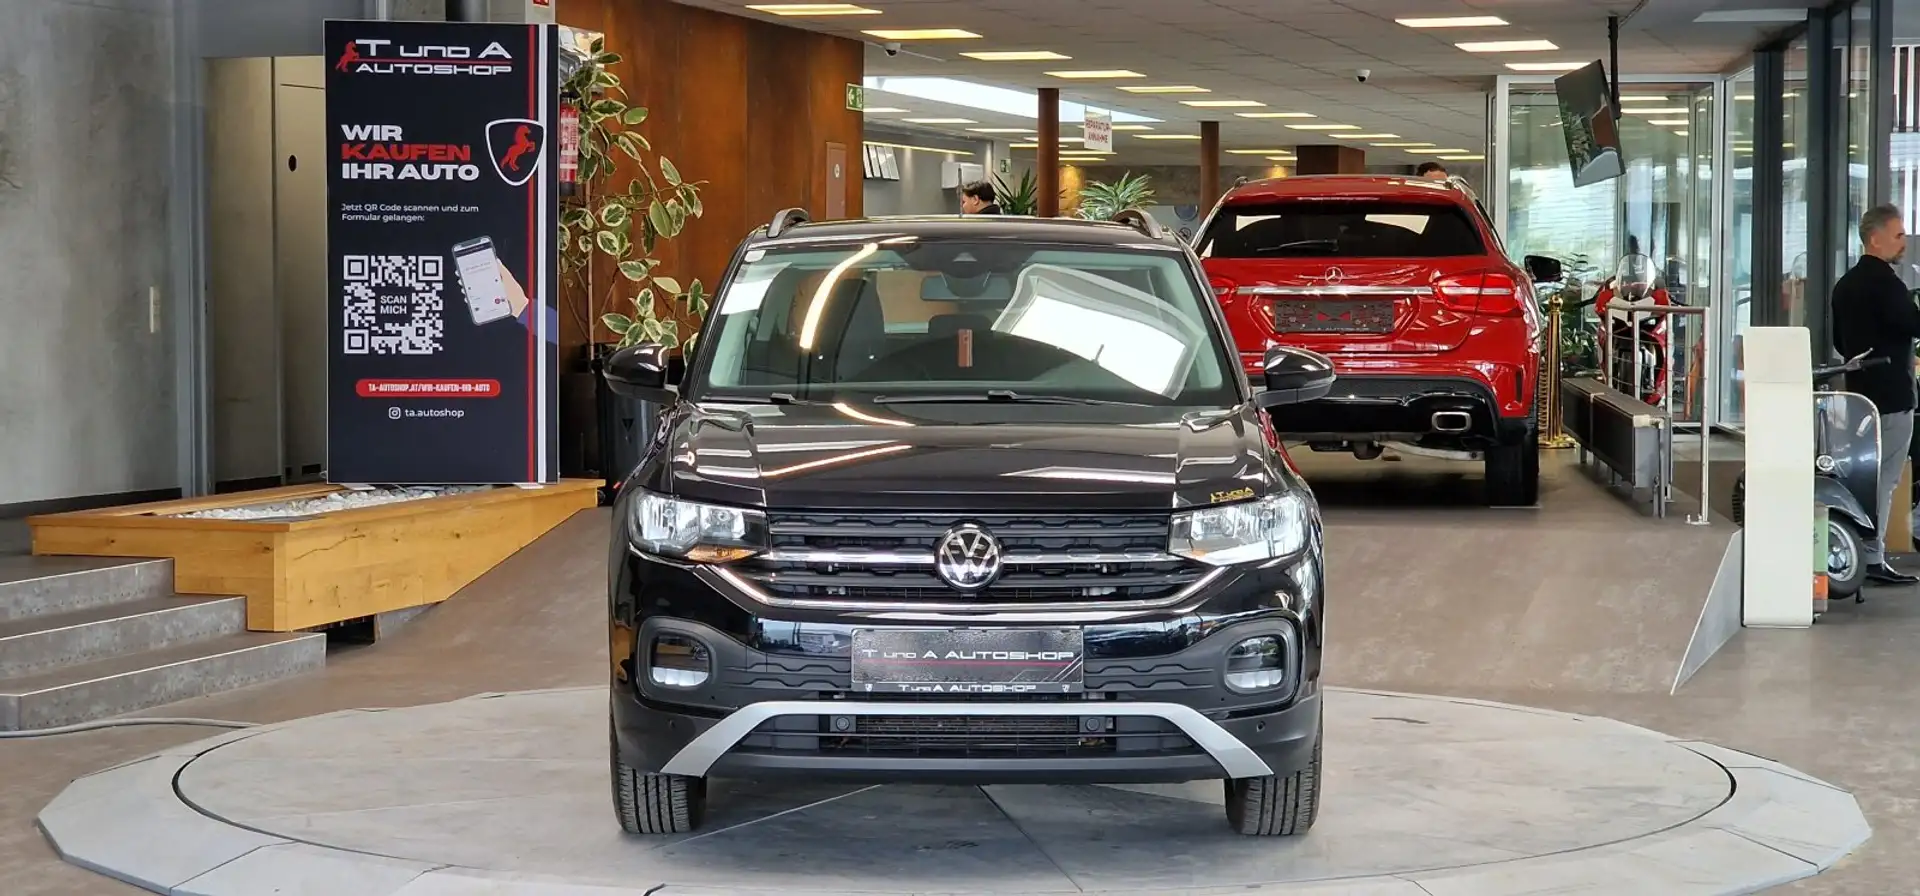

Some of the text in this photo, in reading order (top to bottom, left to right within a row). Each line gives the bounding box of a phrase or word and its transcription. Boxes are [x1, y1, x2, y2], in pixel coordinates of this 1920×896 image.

[355, 39, 391, 57] T
[477, 41, 512, 59] A
[355, 63, 512, 76] AUTOSHOP
[341, 124, 403, 141] WIR
[341, 143, 471, 161] KAUFEN
[342, 163, 480, 181] IHR AUTO
[341, 203, 479, 213] Jetzt QR Code scannen und zum
[341, 213, 425, 224] Formular gelangen:
[380, 295, 407, 305] SCAN
[380, 305, 407, 315] MICH
[404, 408, 465, 419] ta.autoshop
[862, 650, 878, 659] T
[923, 650, 939, 659] A
[945, 651, 1074, 660] AUTOSHOP
[952, 684, 1037, 693] AUTOSHOP
